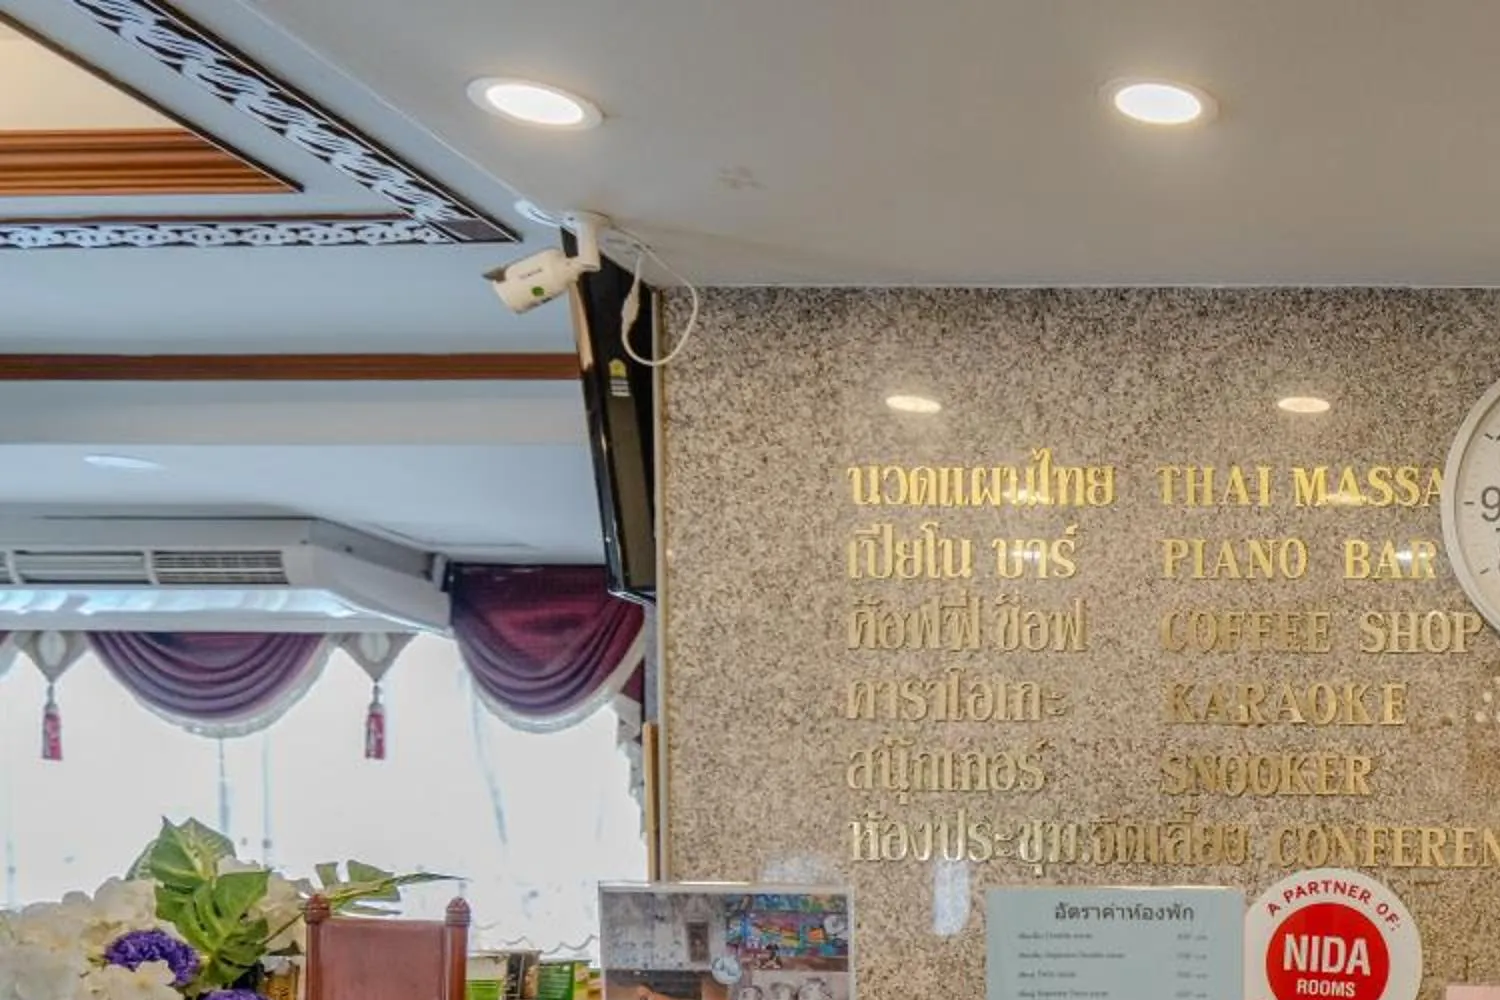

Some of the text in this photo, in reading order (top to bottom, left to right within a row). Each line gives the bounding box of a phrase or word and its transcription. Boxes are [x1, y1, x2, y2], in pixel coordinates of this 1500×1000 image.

[847, 447, 1115, 507] นวดแผนไทย
[1157, 465, 1272, 507] THAI
[850, 522, 1079, 579] เปียโน บาร์
[1160, 538, 1438, 580] PIANO BAR
[1159, 610, 1485, 654] COFFEE SHOP
[1164, 681, 1409, 728] KARAOKE
[1160, 751, 1375, 797] SNOOKER
[1055, 902, 1195, 921] อัตราค่าห้องพัก
[1267, 902, 1281, 917] A
[1283, 879, 1372, 905] PARTNER
[1283, 933, 1371, 976] NIDA
[1296, 979, 1356, 997] ROOMS
